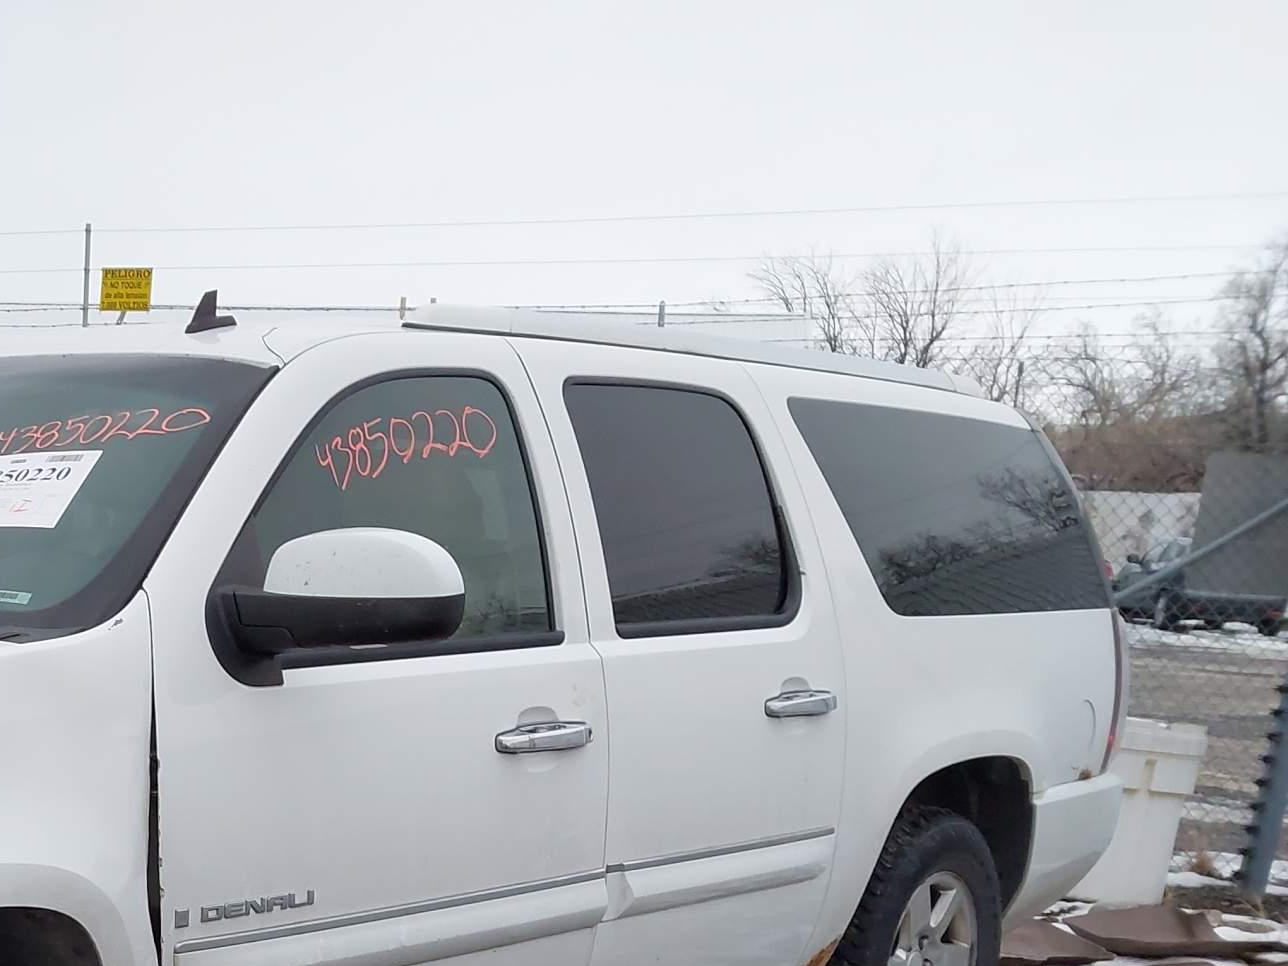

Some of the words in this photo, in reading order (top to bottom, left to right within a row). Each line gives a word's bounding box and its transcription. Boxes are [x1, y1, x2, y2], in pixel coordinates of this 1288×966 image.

[104, 268, 151, 279] PELIGRO
[121, 281, 143, 289] TOQUE
[0, 408, 211, 453] 43850220
[314, 406, 497, 490] 43850220
[200, 890, 314, 923] DENALI
